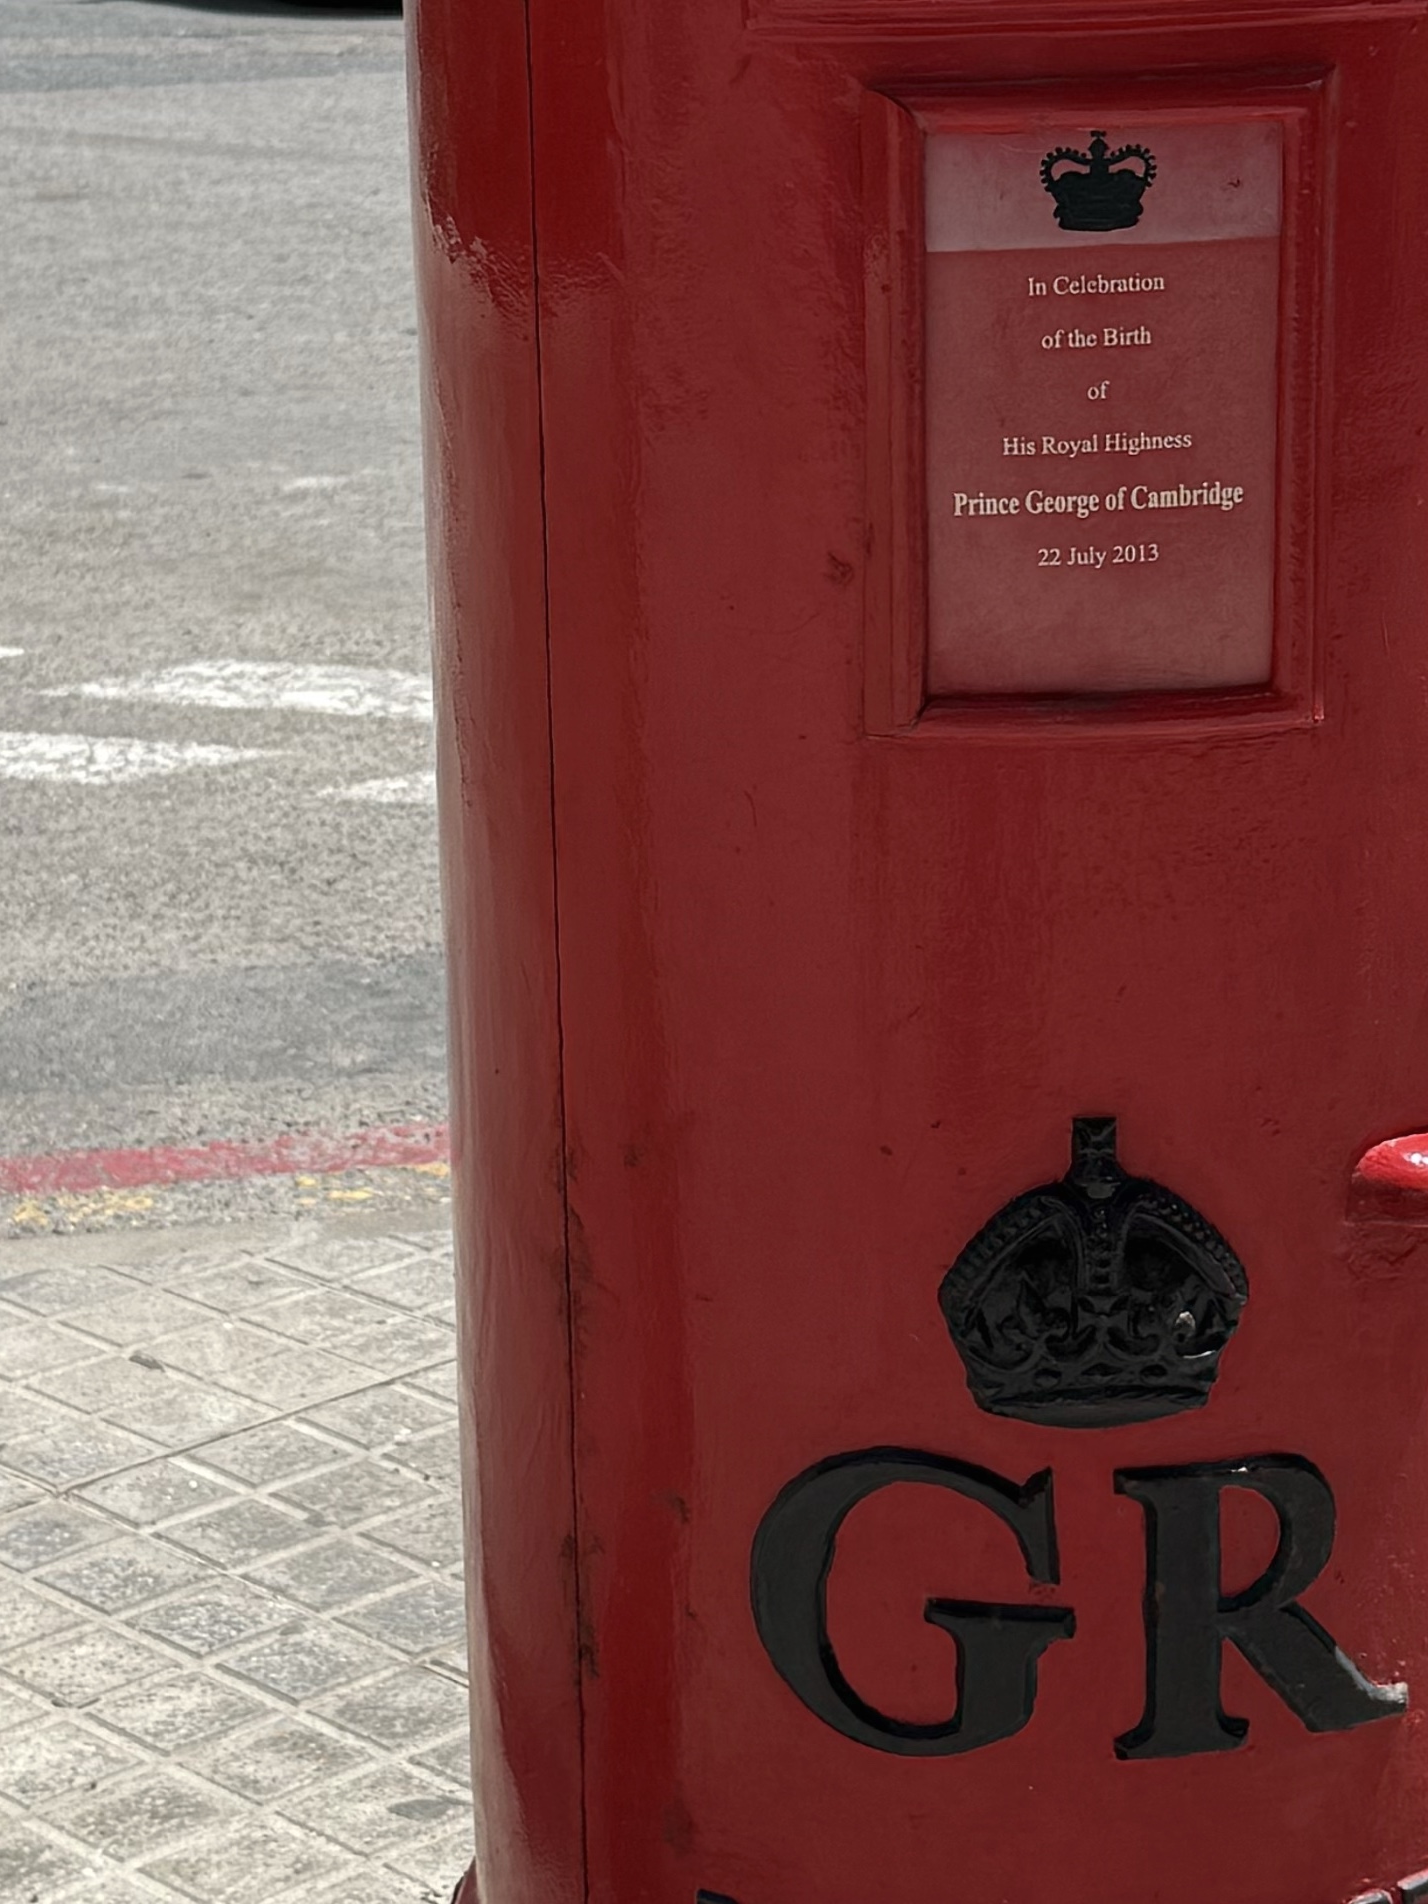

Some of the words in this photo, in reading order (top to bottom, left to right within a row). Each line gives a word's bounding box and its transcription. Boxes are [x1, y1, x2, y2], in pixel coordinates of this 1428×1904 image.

[1027, 277, 1047, 296] In
[1053, 273, 1166, 295] Celebration
[1041, 329, 1065, 349] of
[1068, 329, 1098, 348] the
[1103, 326, 1152, 346] Birth
[1087, 380, 1110, 400] of
[1002, 437, 1036, 456] His
[1041, 434, 1098, 458] Royal
[1105, 431, 1192, 456] Highness
[953, 492, 1020, 517] Prince
[1025, 489, 1100, 519] George
[1105, 487, 1127, 511] of
[1130, 481, 1244, 511] Cambridge
[1037, 548, 1061, 567] 22
[1067, 546, 1107, 569] July
[1112, 544, 1160, 564] 2013
[749, 1444, 1410, 1761] GR
